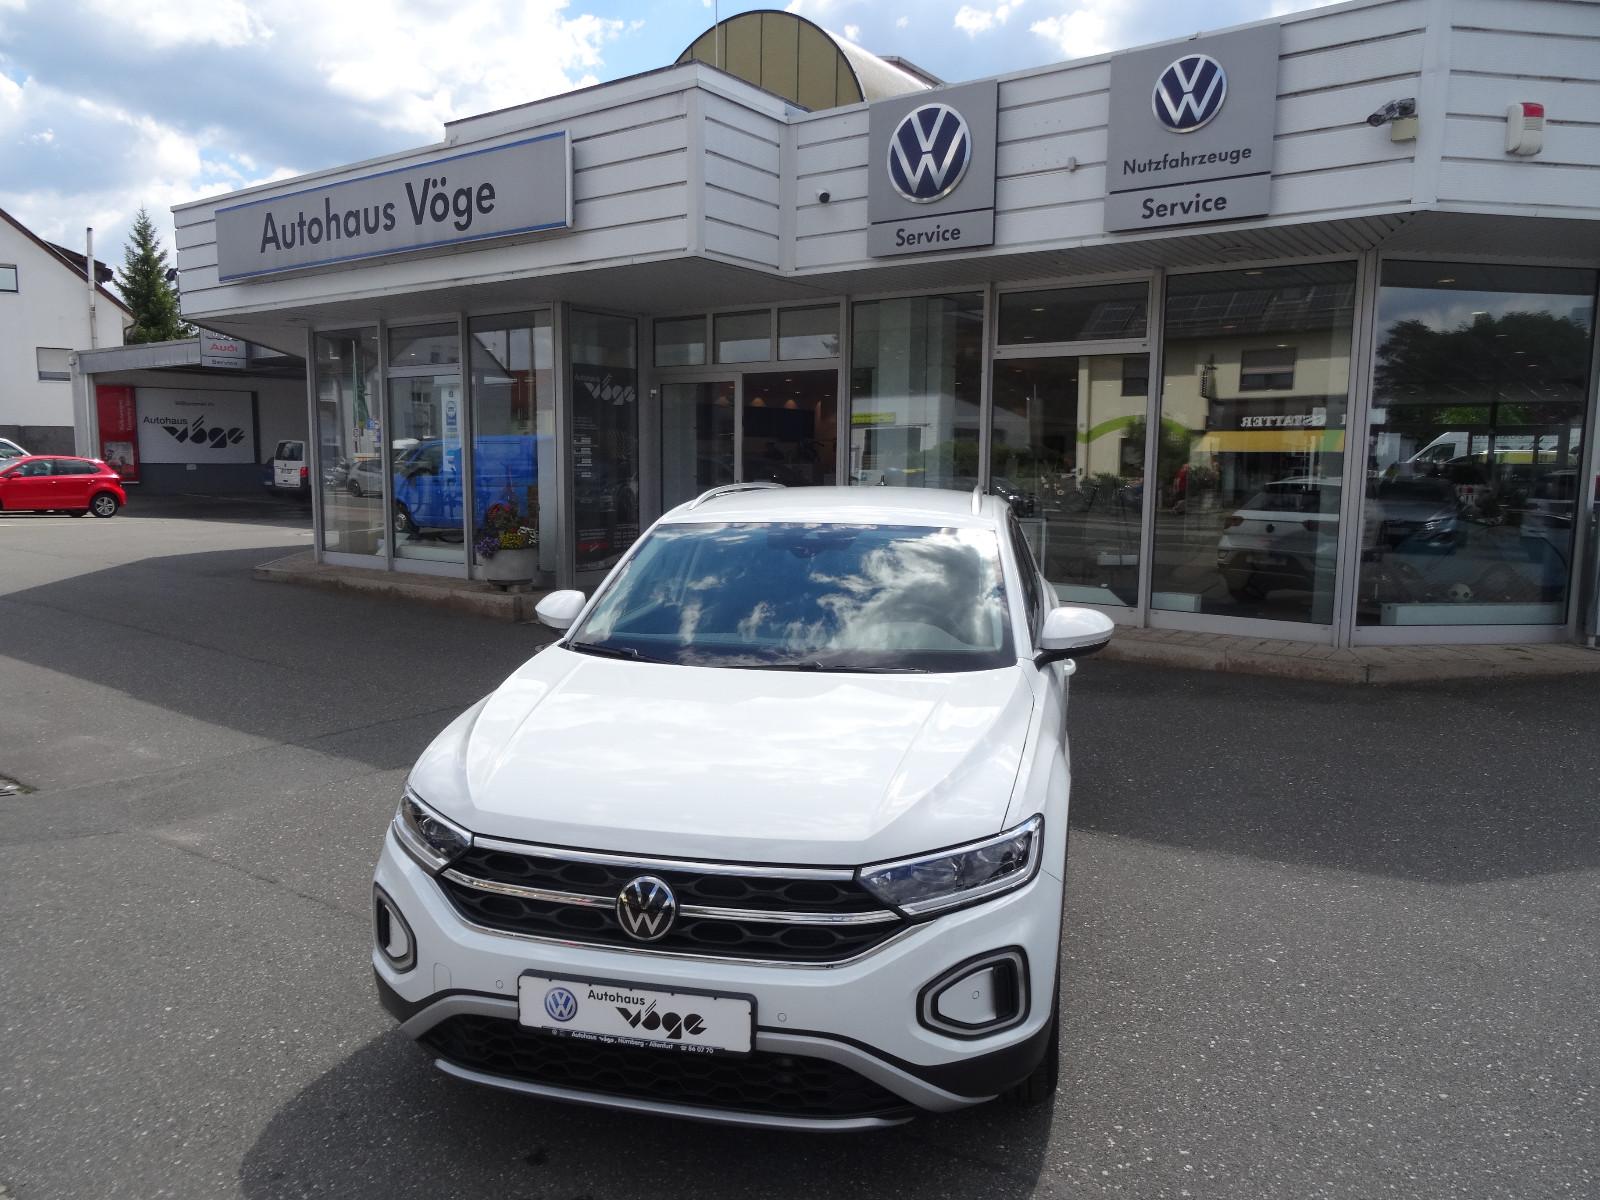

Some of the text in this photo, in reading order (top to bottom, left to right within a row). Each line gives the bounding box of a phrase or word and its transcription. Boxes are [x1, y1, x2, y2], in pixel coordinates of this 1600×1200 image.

[1123, 148, 1252, 175] Nutzfahrzeuge
[260, 176, 496, 253] Autohaus Vöge
[1142, 193, 1228, 219] Service
[895, 224, 961, 247] Service
[209, 342, 238, 353] Audi
[143, 416, 188, 425] Autohaus
[588, 989, 646, 1006] Autohaus
[571, 1031, 597, 1041] Autohaus
